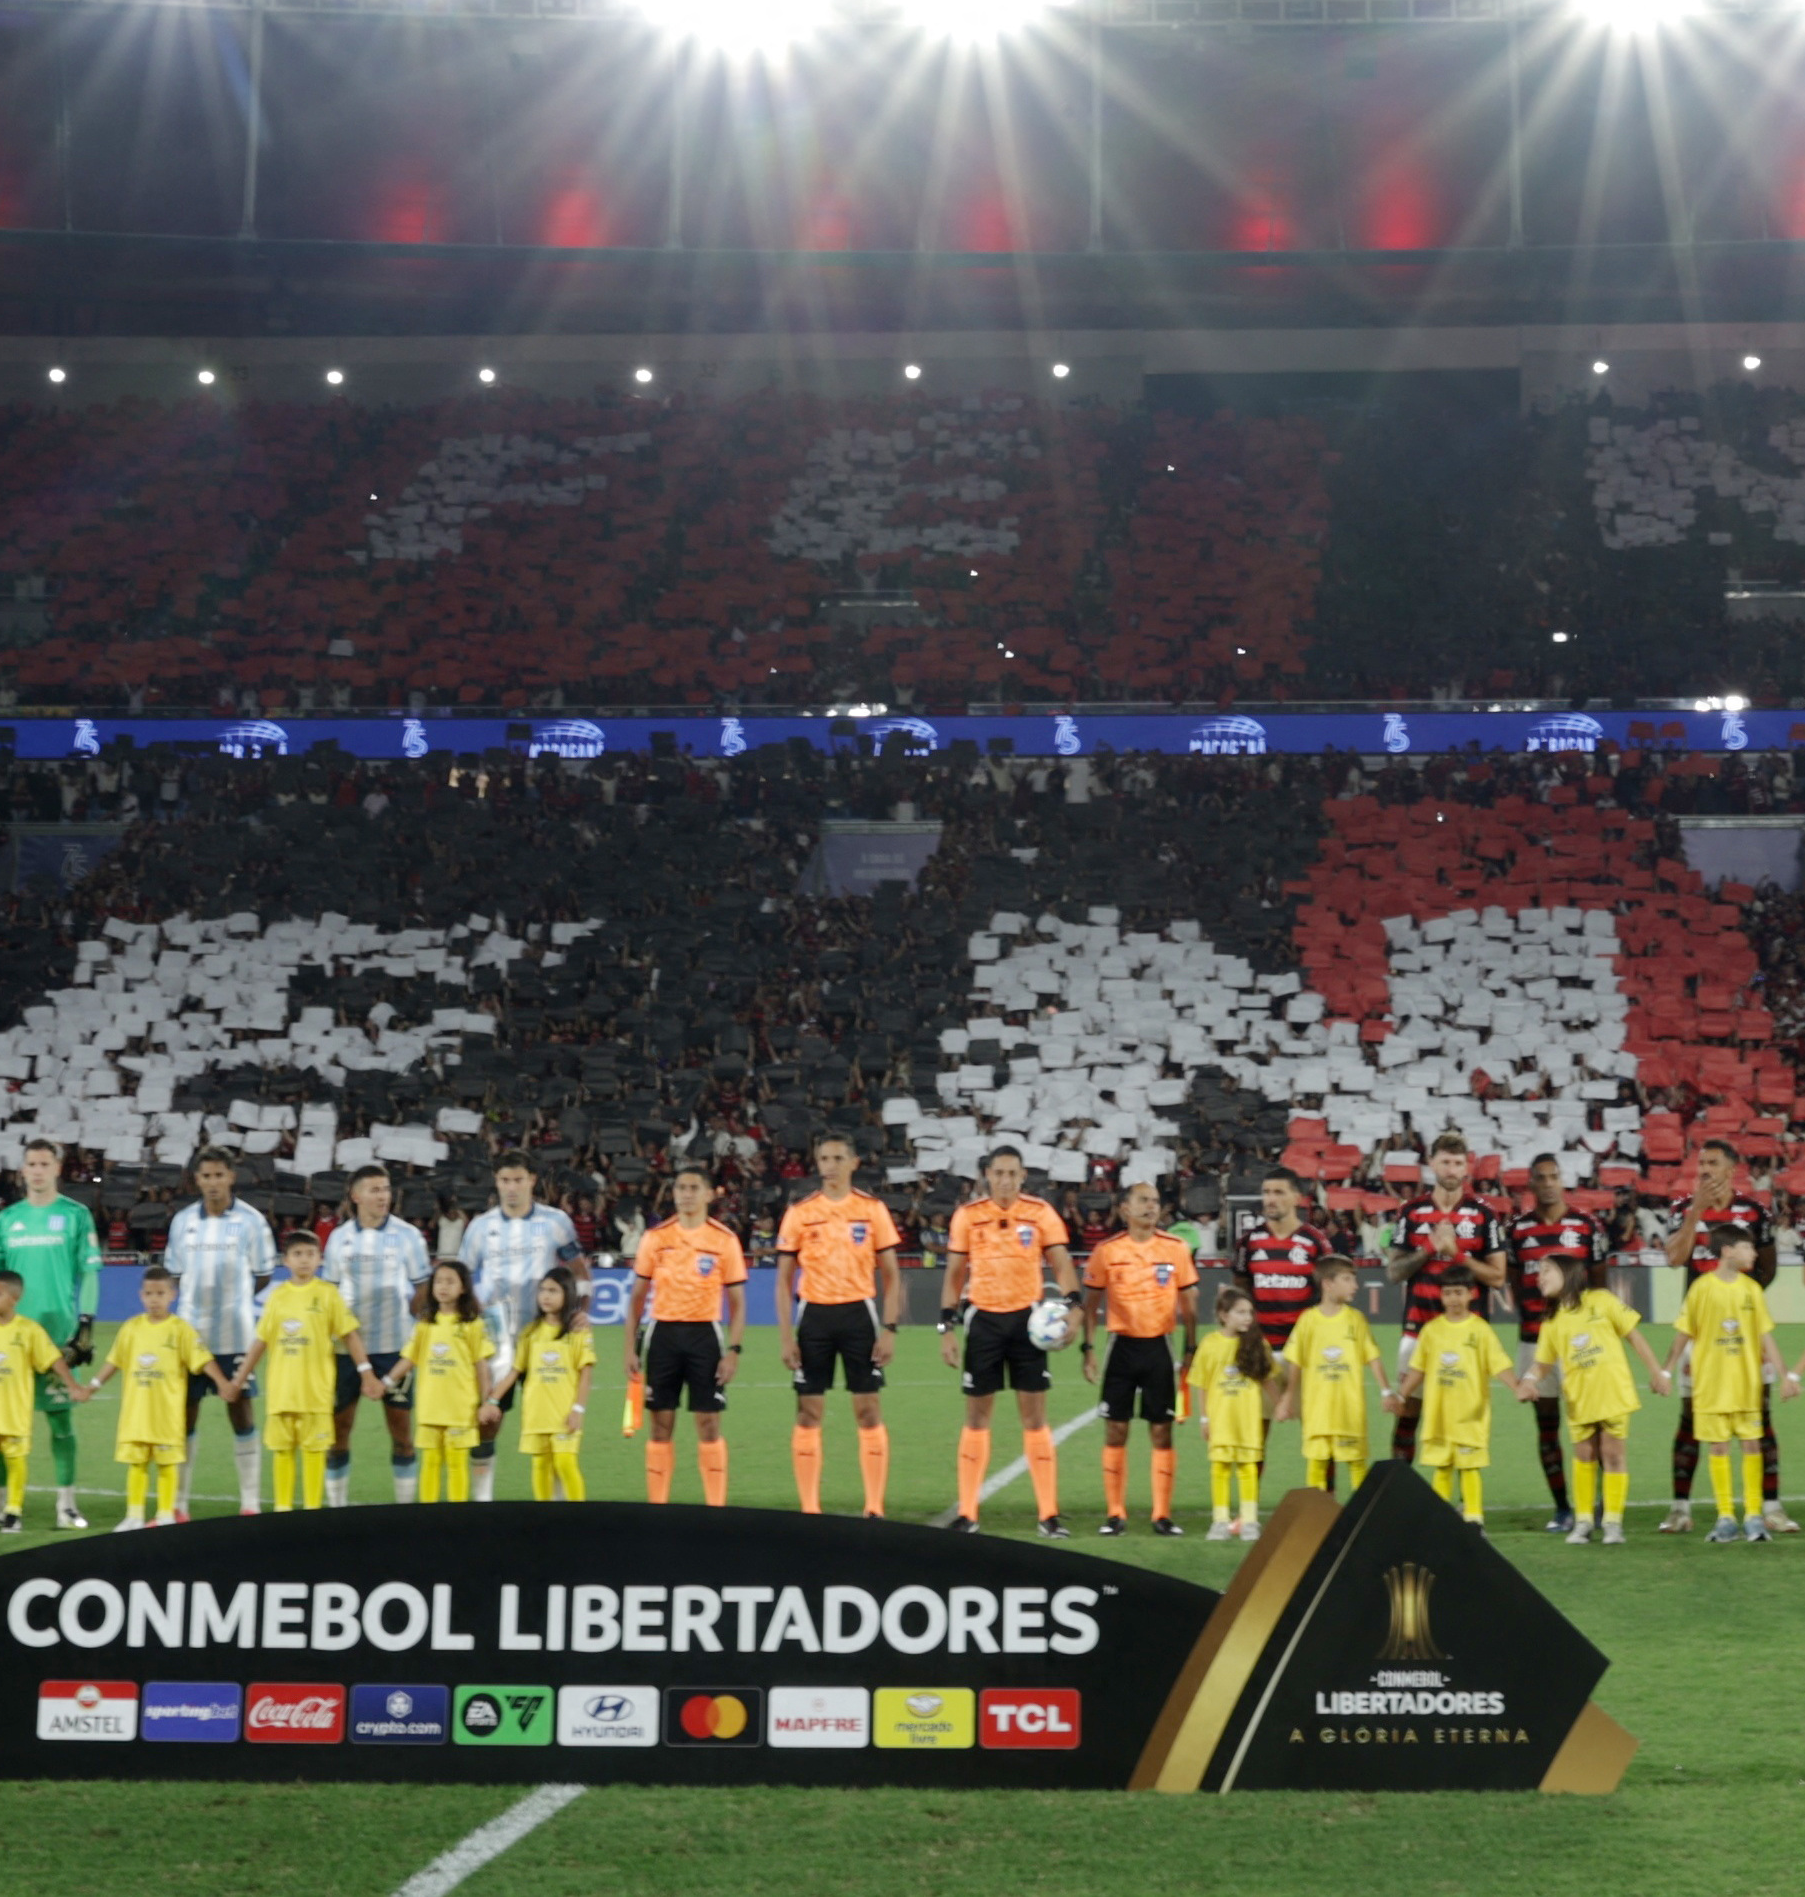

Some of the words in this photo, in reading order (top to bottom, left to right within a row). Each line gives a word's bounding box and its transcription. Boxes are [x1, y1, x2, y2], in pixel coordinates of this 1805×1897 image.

[7, 1578, 475, 1651] CONMEBOL
[499, 1584, 1101, 1654] LIBERTADORES
[1316, 1691, 1505, 1715] LIBERTADORES
[49, 1715, 124, 1734] AMSTEL
[775, 1717, 862, 1732] MAPFRE
[895, 1720, 954, 1734] mercado
[988, 1703, 1072, 1733] TCL
[572, 1726, 645, 1738] HYUNDAI
[1289, 1728, 1305, 1743] A
[1434, 1727, 1530, 1744] ETERNA
